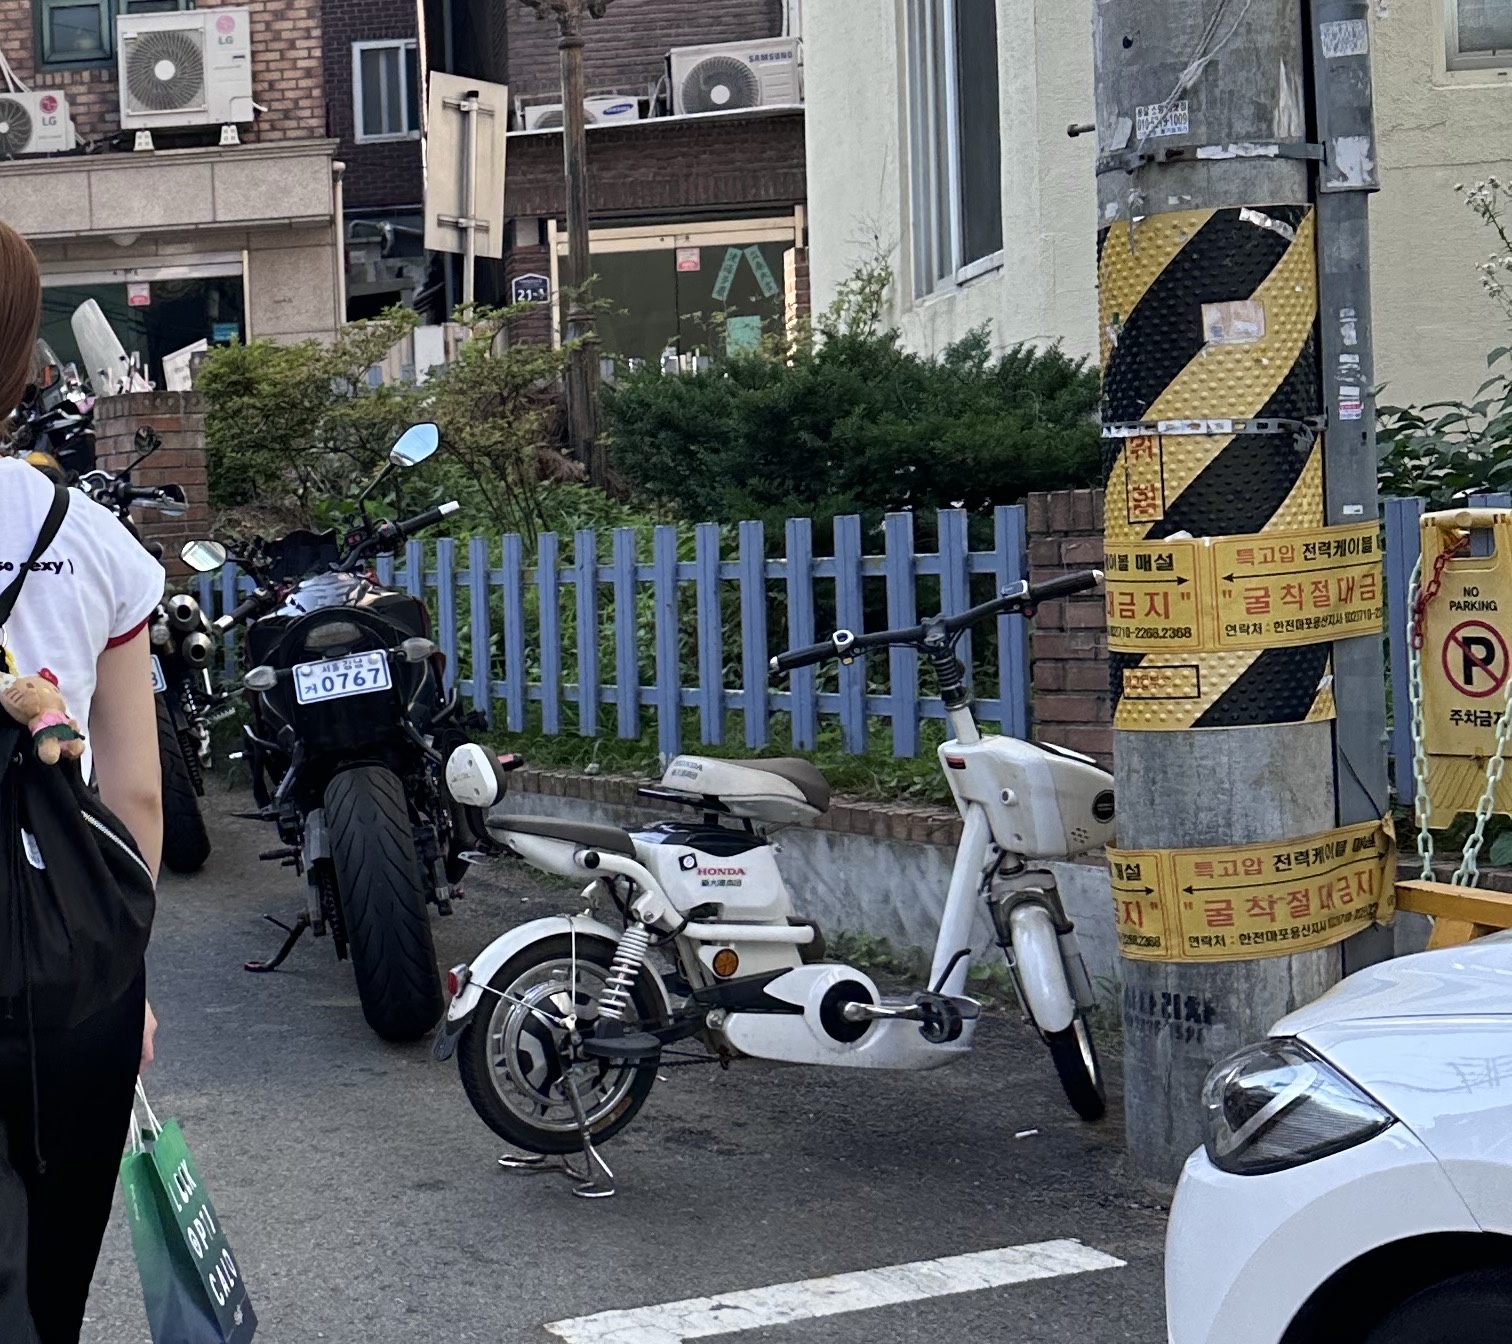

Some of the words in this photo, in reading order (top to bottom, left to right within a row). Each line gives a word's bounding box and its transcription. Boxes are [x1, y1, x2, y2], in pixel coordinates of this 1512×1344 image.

[218, 35, 234, 46] LG
[748, 50, 793, 64] SAMSUNG
[42, 116, 57, 127] LG
[1235, 543, 1296, 566] 특고압
[1302, 535, 1373, 562] 전력케이블
[1135, 552, 1174, 572] 매설
[1462, 586, 1480, 598] NO
[1449, 600, 1498, 612] PARKING
[1224, 621, 1263, 637] 연락처
[304, 683, 318, 695] 거
[321, 667, 381, 693] 0767
[1194, 857, 1264, 879] 특고압
[1271, 838, 1349, 873] 전력케이블
[697, 867, 746, 876] HONDA
[1188, 934, 1227, 949] 연락처
